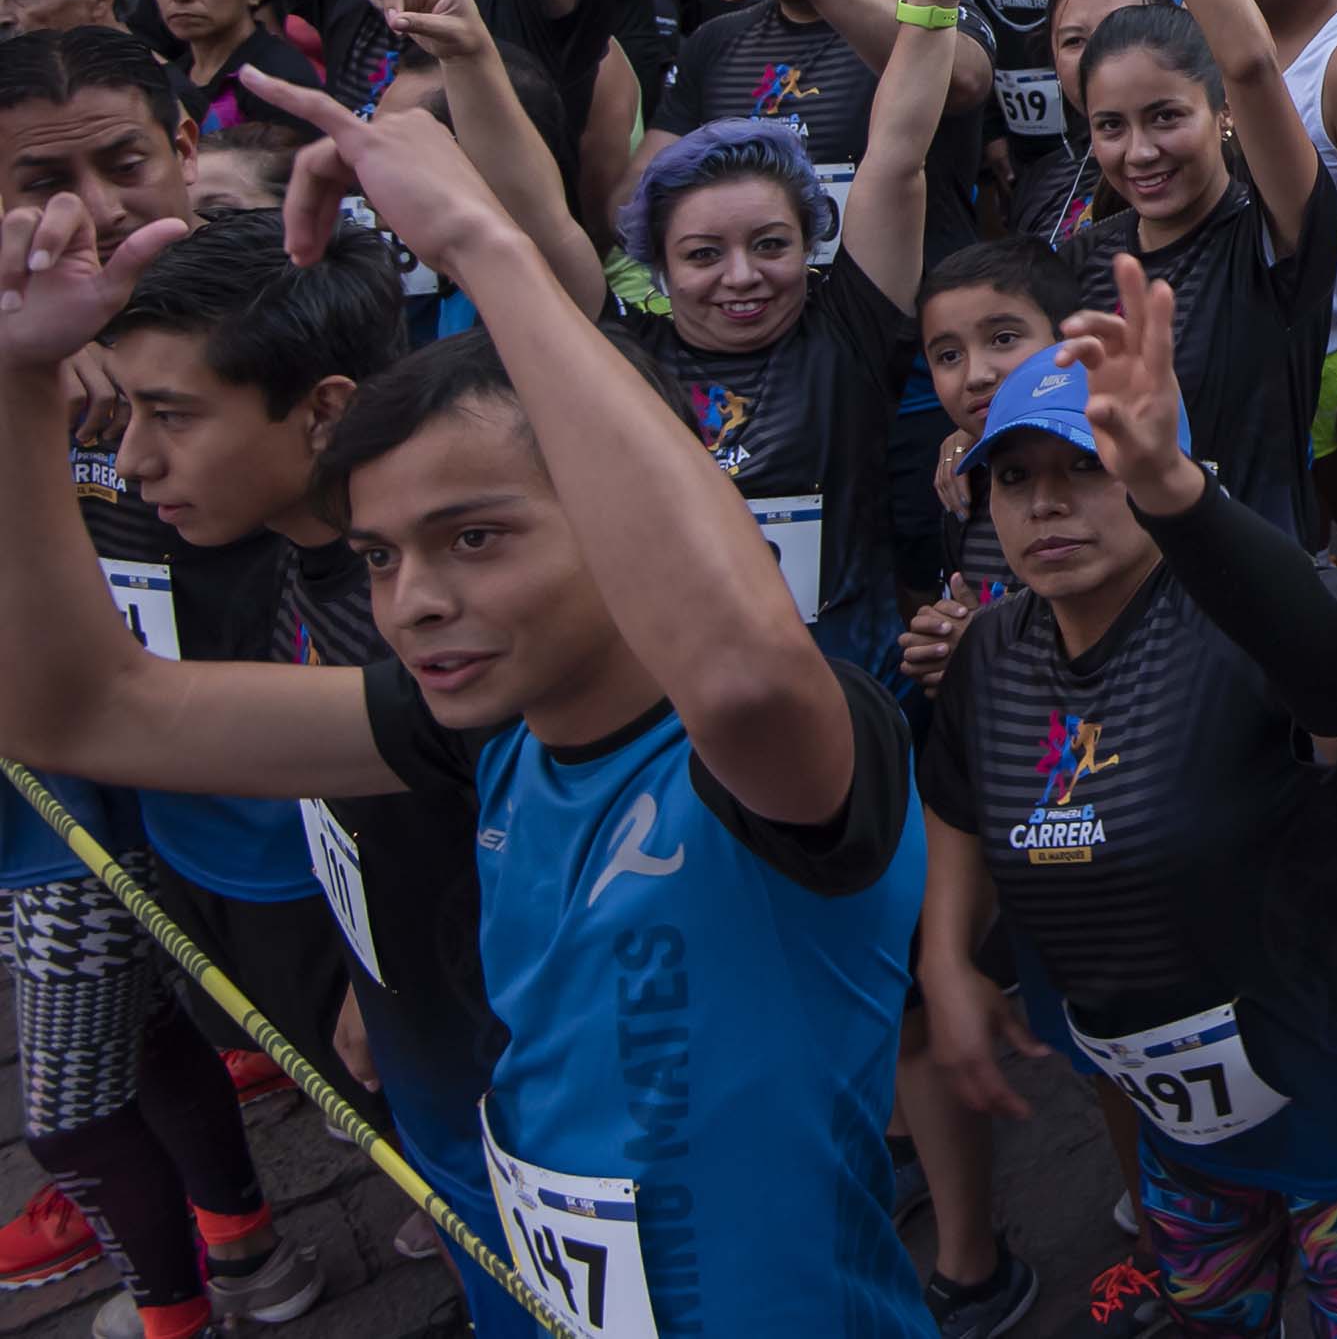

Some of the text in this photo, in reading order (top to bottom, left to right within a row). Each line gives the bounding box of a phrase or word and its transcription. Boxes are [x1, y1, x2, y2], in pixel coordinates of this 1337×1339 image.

[1001, 90, 1047, 122] 519
[1038, 373, 1072, 388] NIKE
[1009, 819, 1106, 849] CARRERA
[513, 1206, 608, 1330] 147
